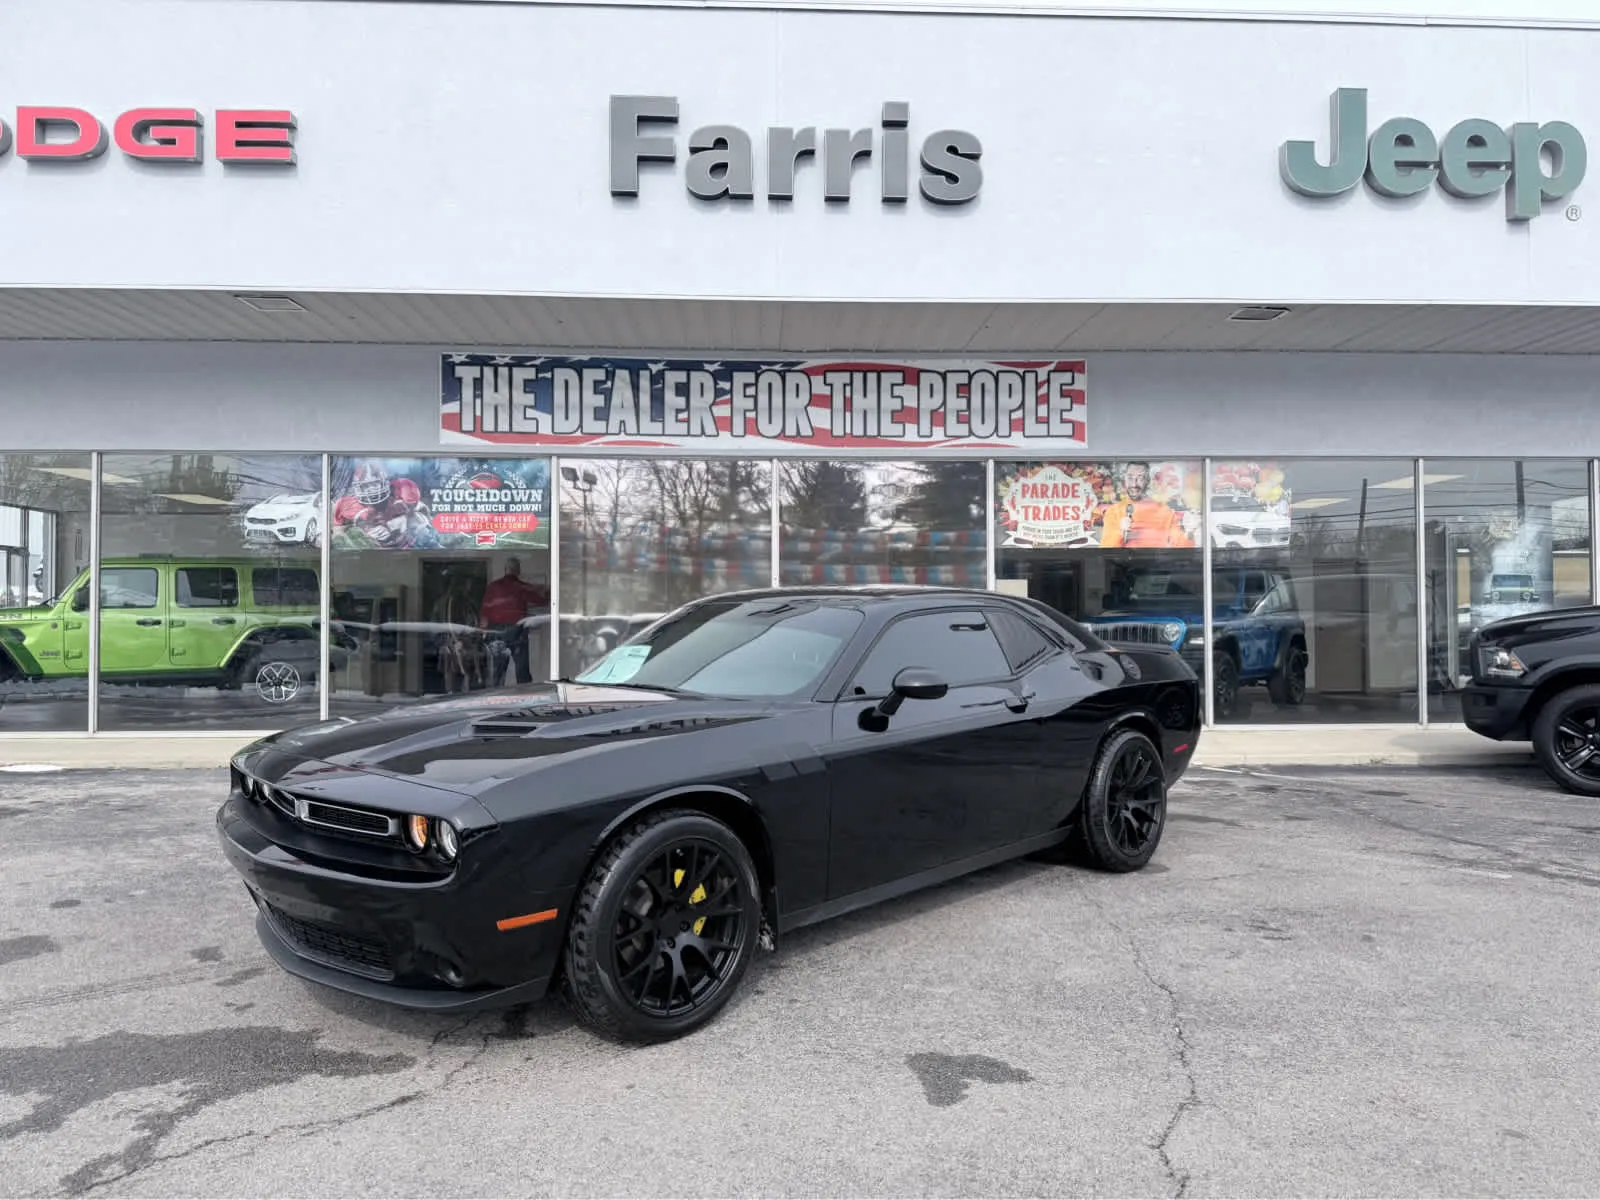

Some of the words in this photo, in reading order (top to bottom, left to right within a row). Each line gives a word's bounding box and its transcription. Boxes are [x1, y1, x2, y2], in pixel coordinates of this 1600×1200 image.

[0, 106, 297, 166] DGE
[610, 95, 984, 206] Farris
[1279, 88, 1587, 221] Jeep
[453, 365, 539, 434] THE
[551, 366, 719, 437] DEALER
[731, 368, 815, 438] FOR
[824, 369, 906, 438] THE
[916, 369, 1075, 438] PEOPLE
[430, 489, 543, 502] TOUCHDOWN
[431, 504, 451, 512] FOR
[454, 504, 474, 512] NOT
[477, 504, 505, 512] MUCH
[509, 504, 542, 512] DOWN!
[1021, 483, 1080, 499] PARADE
[1021, 505, 1080, 521] TRADES
